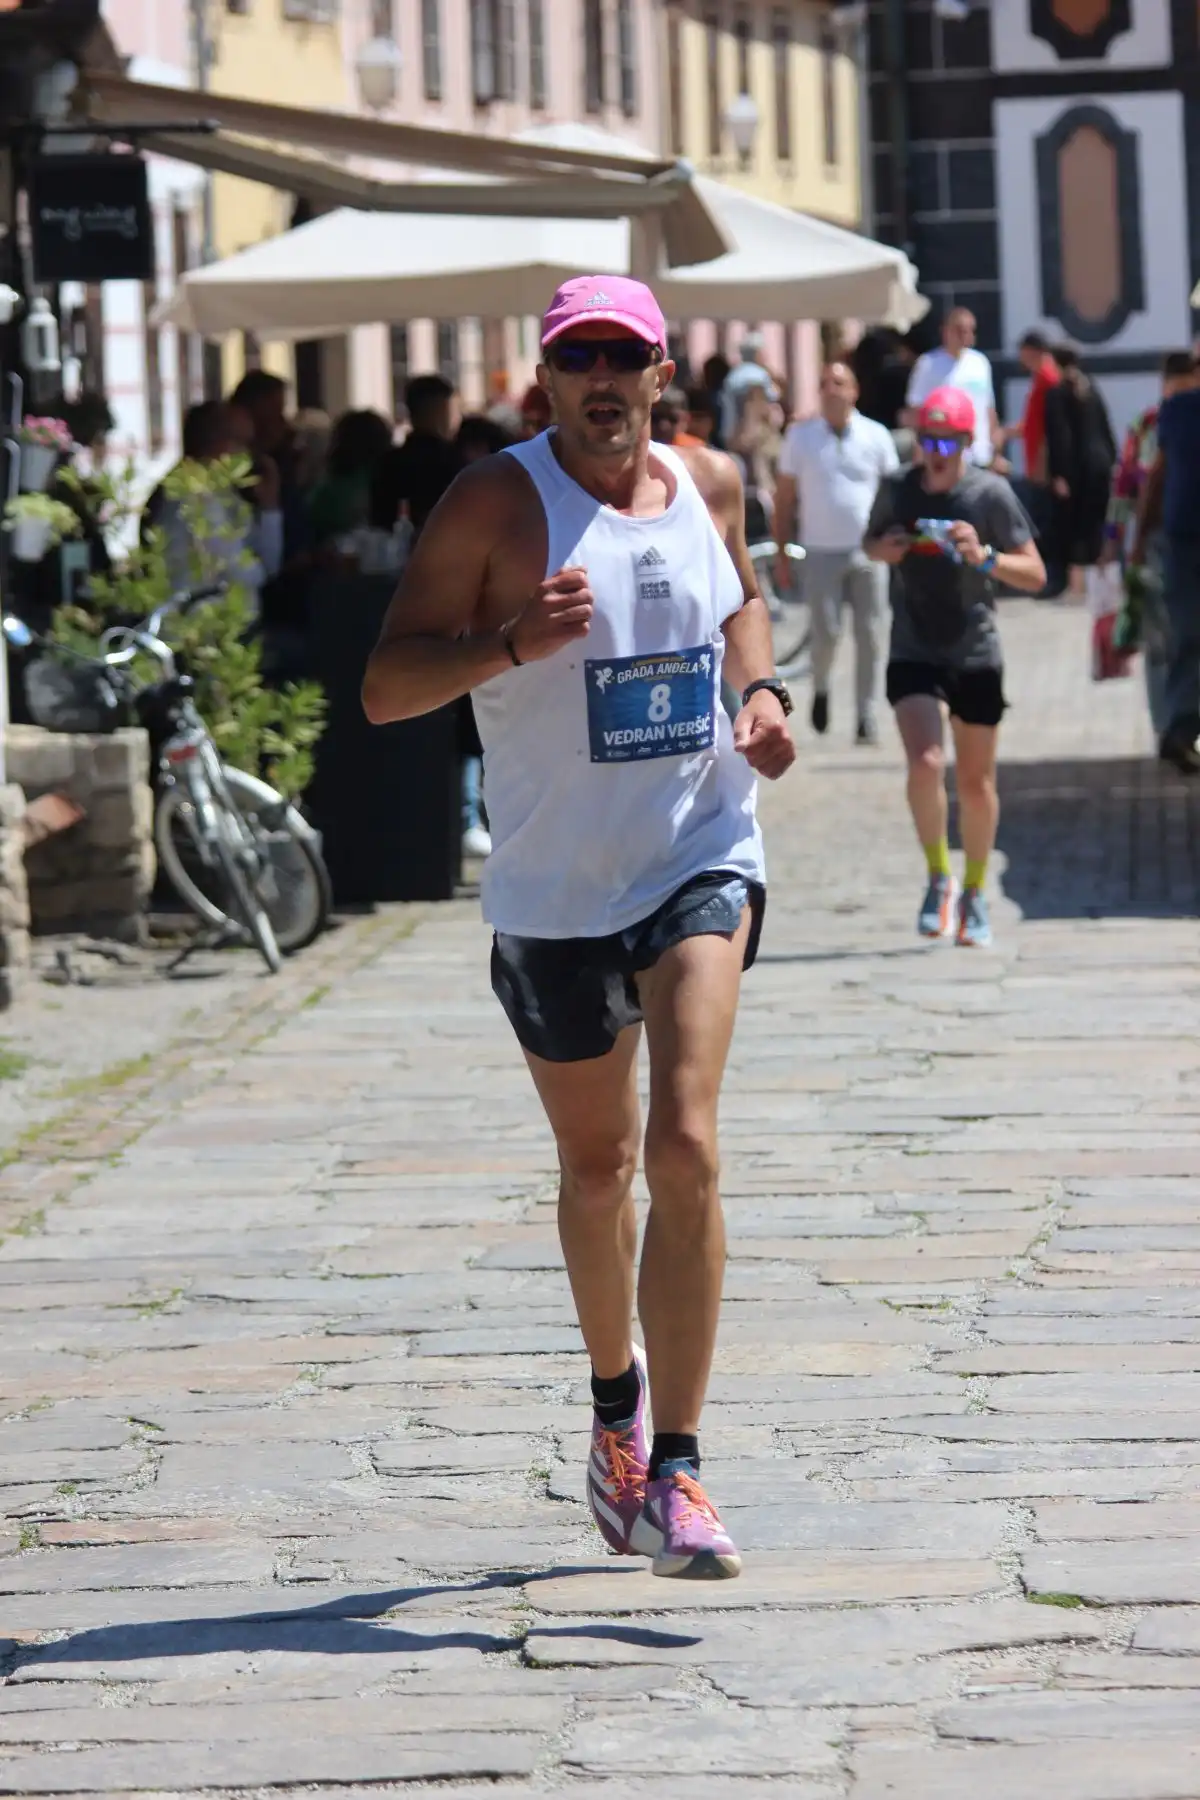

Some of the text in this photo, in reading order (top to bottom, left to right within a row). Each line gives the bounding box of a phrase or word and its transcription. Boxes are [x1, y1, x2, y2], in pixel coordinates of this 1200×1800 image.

[617, 664, 654, 684] GRADA
[647, 683, 672, 722] 8
[603, 712, 711, 746] VEDRAN VERŠIĆ
